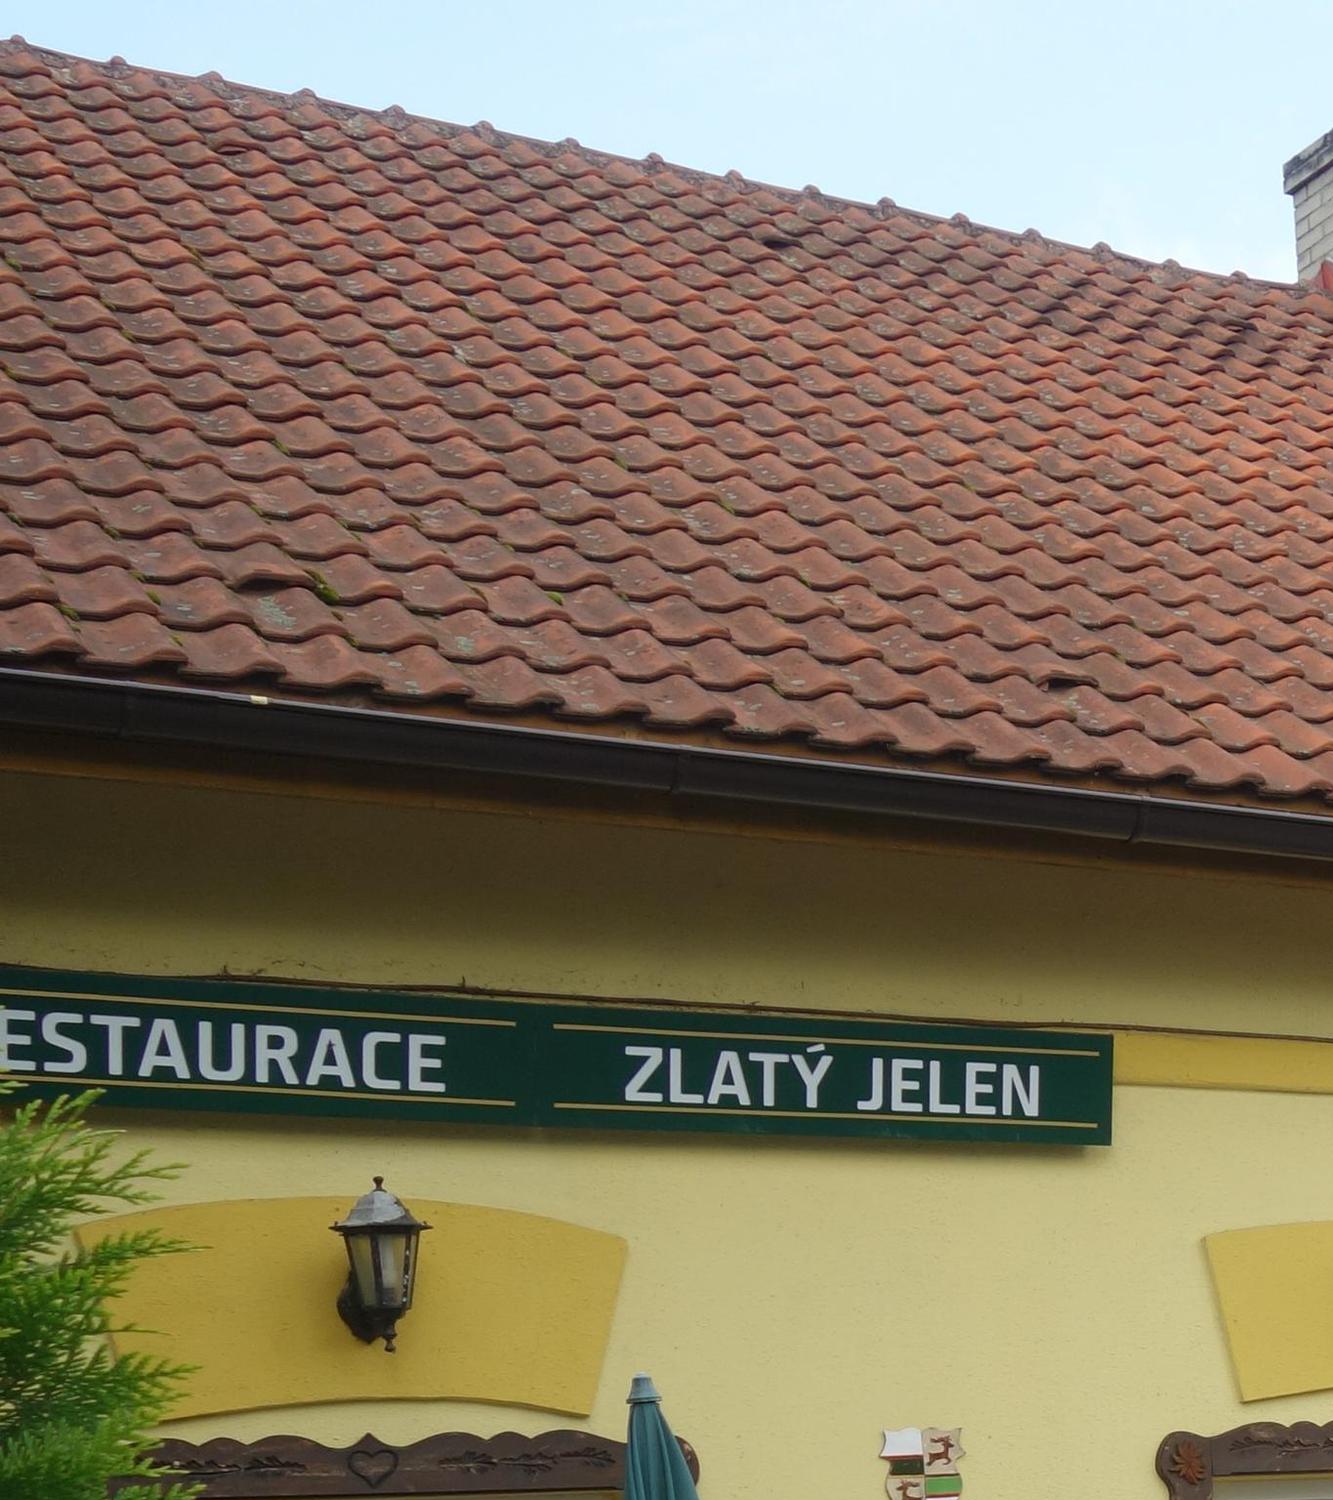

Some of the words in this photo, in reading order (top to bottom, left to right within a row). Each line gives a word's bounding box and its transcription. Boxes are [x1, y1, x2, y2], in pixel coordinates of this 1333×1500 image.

[0, 1009, 446, 1093] ESTAURACE
[624, 1043, 834, 1108] ZLATÝ
[856, 1057, 1040, 1117] JELEN
